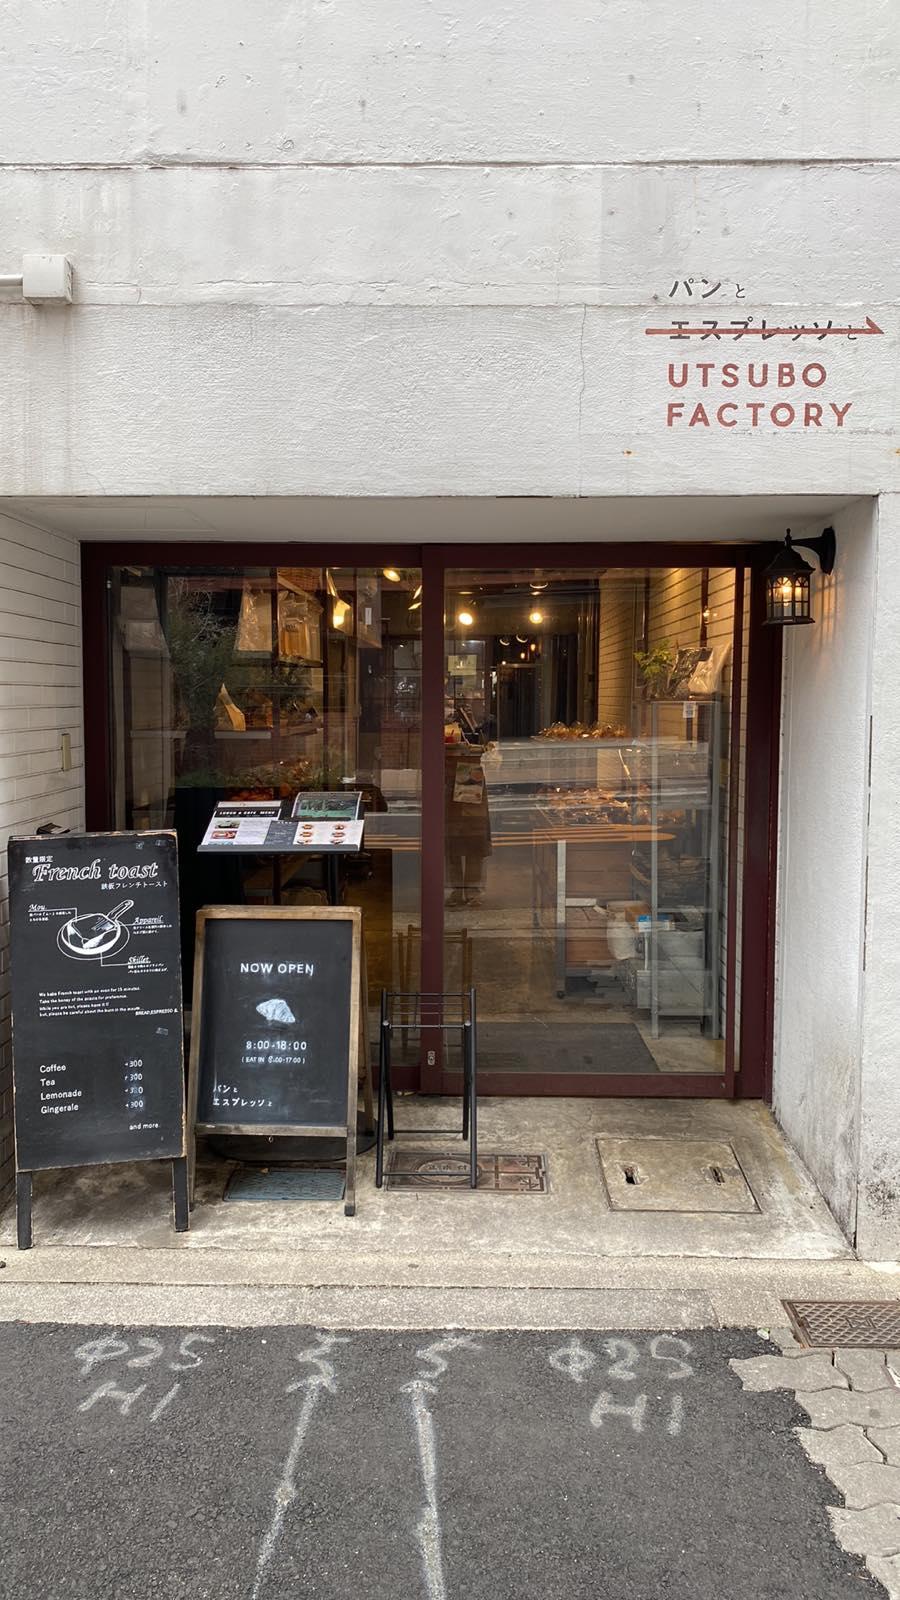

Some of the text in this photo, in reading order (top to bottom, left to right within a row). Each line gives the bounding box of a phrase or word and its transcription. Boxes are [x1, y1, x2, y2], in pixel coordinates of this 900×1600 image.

[669, 278, 746, 299] パンと
[669, 316, 857, 341] エスプレッソと
[668, 362, 828, 388] UTSUBO
[667, 402, 853, 427] FACTORY
[32, 858, 159, 882] French toast
[240, 963, 314, 976] NOW OPEN
[40, 1063, 67, 1073] Coffee
[40, 1078, 56, 1087] Tea
[213, 1084, 239, 1093] パンと
[40, 1089, 82, 1101] Lemonade
[213, 1097, 273, 1107] エスプレッソと
[41, 1103, 79, 1115] Gingerale
